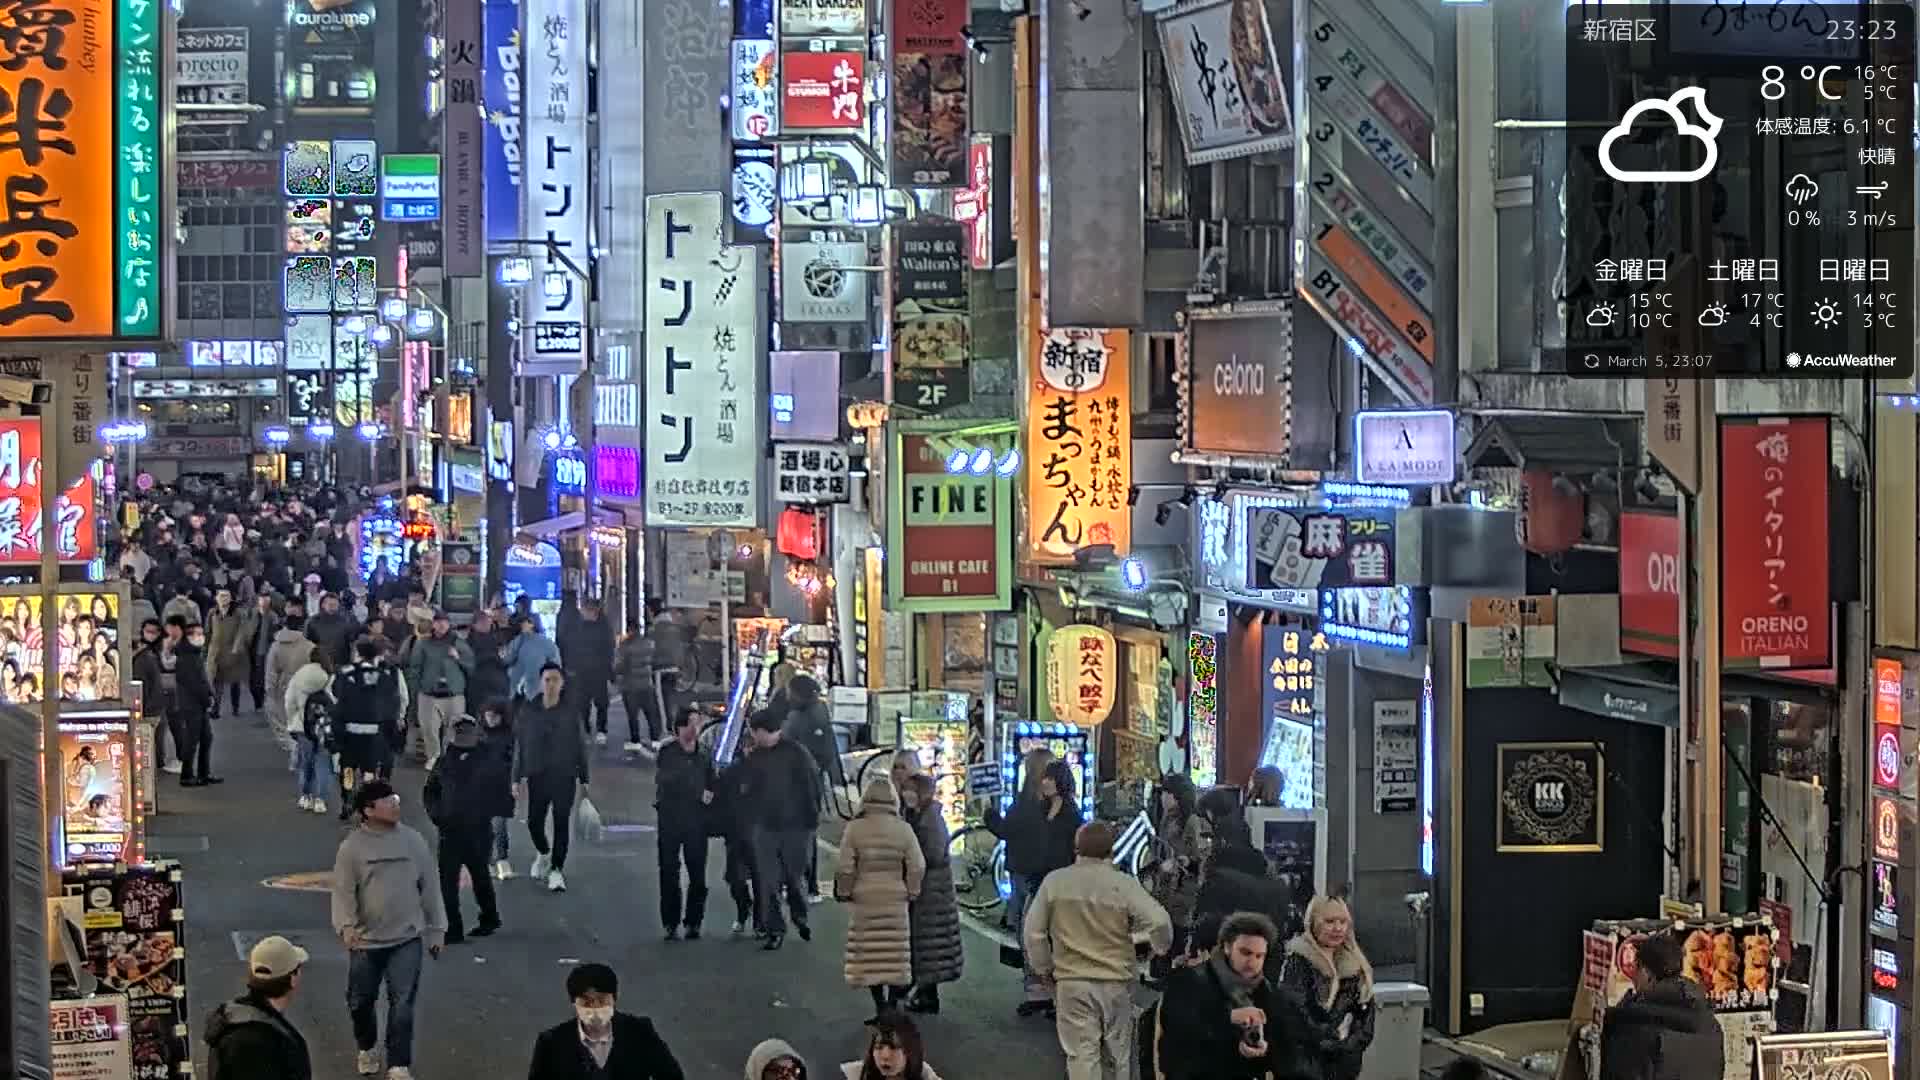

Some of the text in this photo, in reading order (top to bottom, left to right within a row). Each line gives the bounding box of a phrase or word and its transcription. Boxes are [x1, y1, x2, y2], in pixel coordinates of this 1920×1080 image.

[1315, 22, 1335, 43] 5
[1314, 74, 1334, 92] 4
[1315, 123, 1335, 143] 3
[1314, 173, 1334, 194] 2
[901, 256, 960, 272] Walton's
[1312, 269, 1340, 298] B1
[660, 208, 692, 463] トントン
[1213, 351, 1265, 395] celona
[712, 325, 738, 444] 焼とん酒場
[918, 386, 947, 405] 2F
[780, 450, 844, 471] 酒場心
[1042, 396, 1086, 545] まっちゃん
[780, 475, 844, 494] 新宿本店
[911, 485, 987, 514] FINE
[1350, 521, 1391, 535] フリー
[1755, 432, 1790, 606] 俺のイタリアン
[1647, 551, 1680, 593] OR
[1742, 616, 1808, 635] ORENO
[1740, 634, 1809, 653] ITALIAN
[1535, 782, 1565, 800] KK
